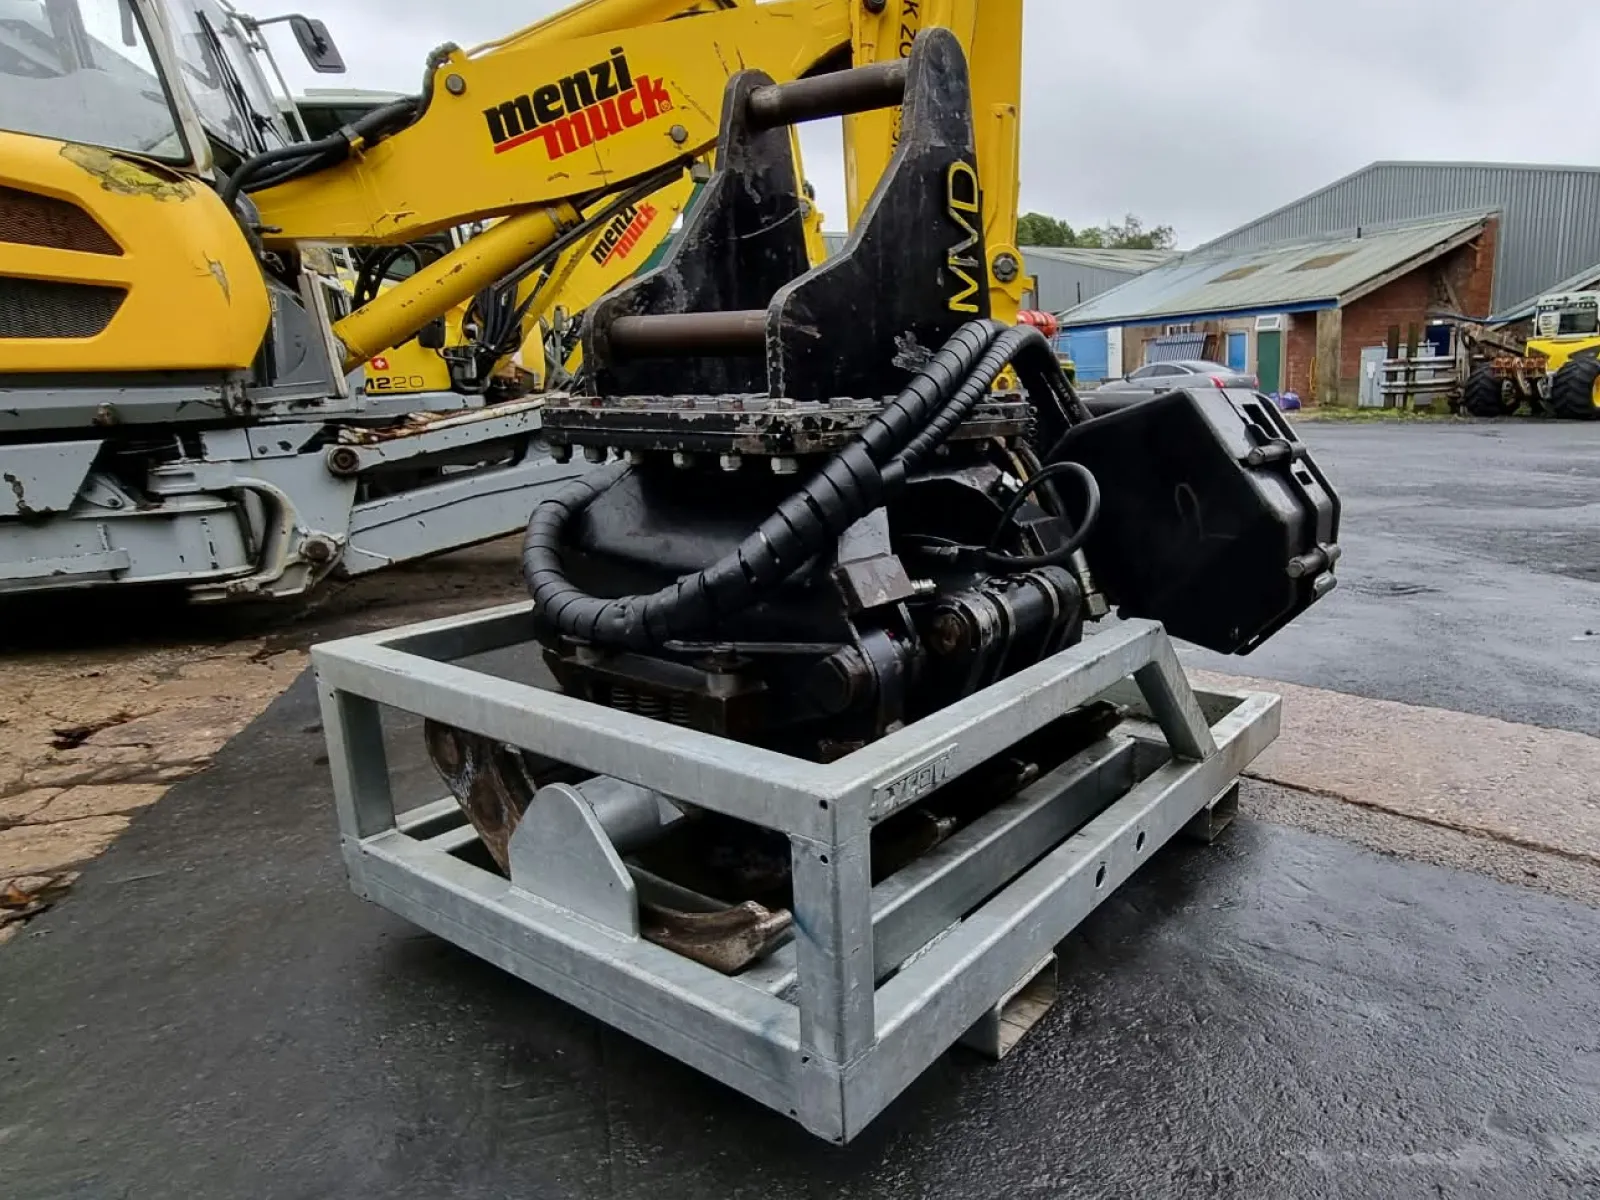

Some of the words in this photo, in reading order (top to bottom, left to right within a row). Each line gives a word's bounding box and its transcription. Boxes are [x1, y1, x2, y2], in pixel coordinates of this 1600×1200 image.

[483, 46, 634, 144] menzi
[494, 75, 674, 161] muck
[591, 204, 638, 265] menzi
[601, 201, 659, 268] muck
